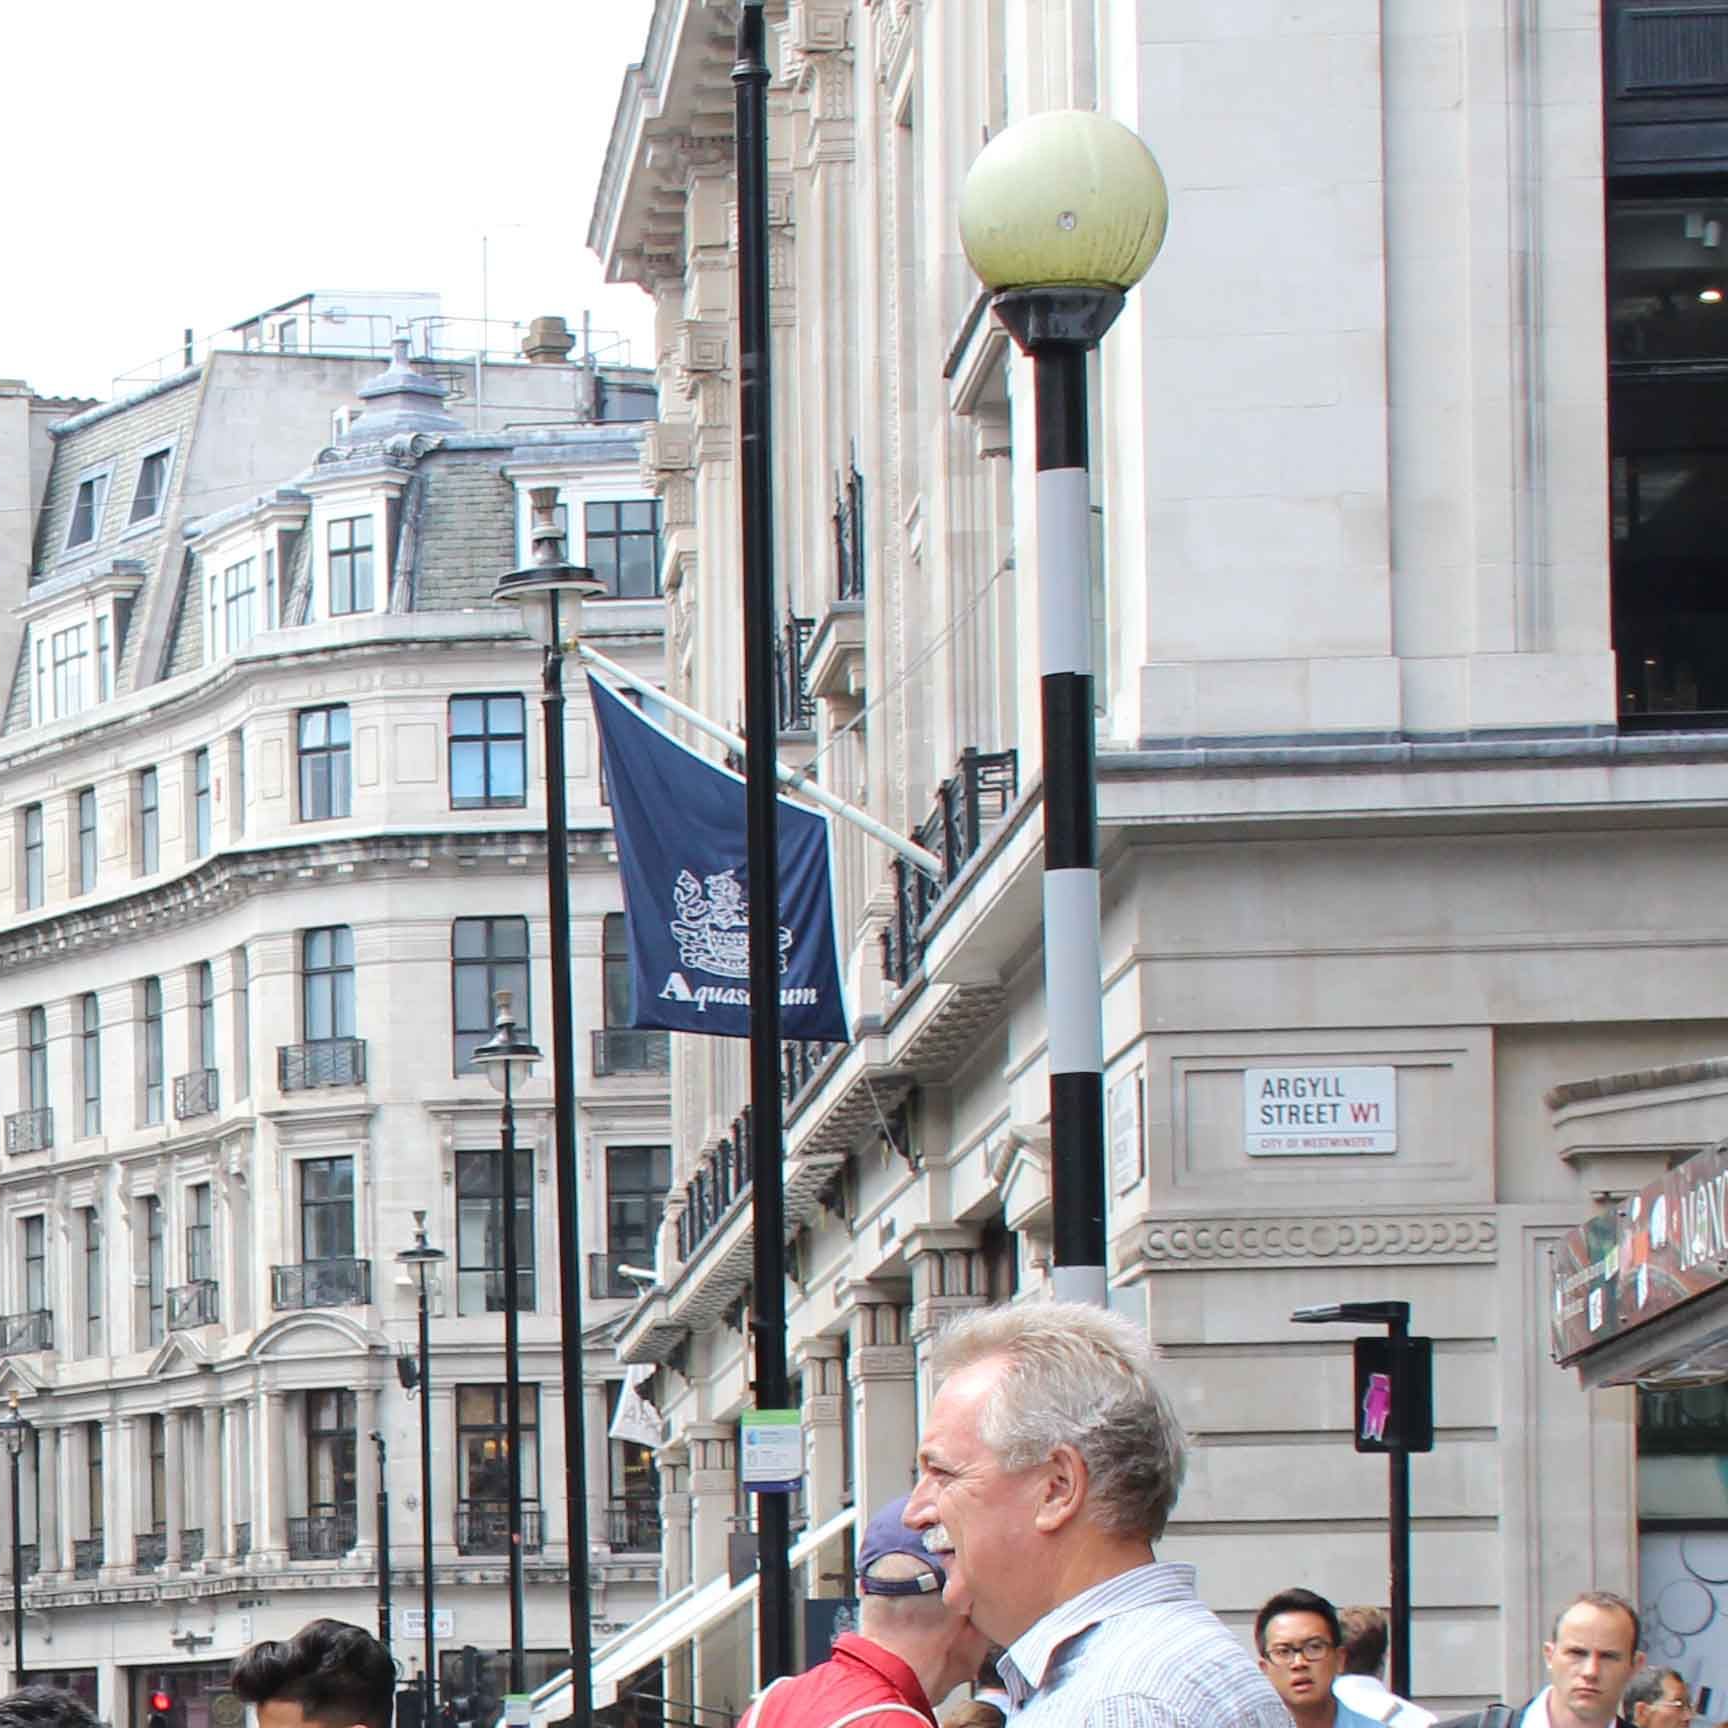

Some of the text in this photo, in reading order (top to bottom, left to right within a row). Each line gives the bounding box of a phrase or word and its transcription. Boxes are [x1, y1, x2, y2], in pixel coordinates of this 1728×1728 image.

[1261, 1077, 1346, 1098] ARGYLL
[1261, 1103, 1381, 1125] STREET W1
[1261, 1138, 1282, 1149] CITY
